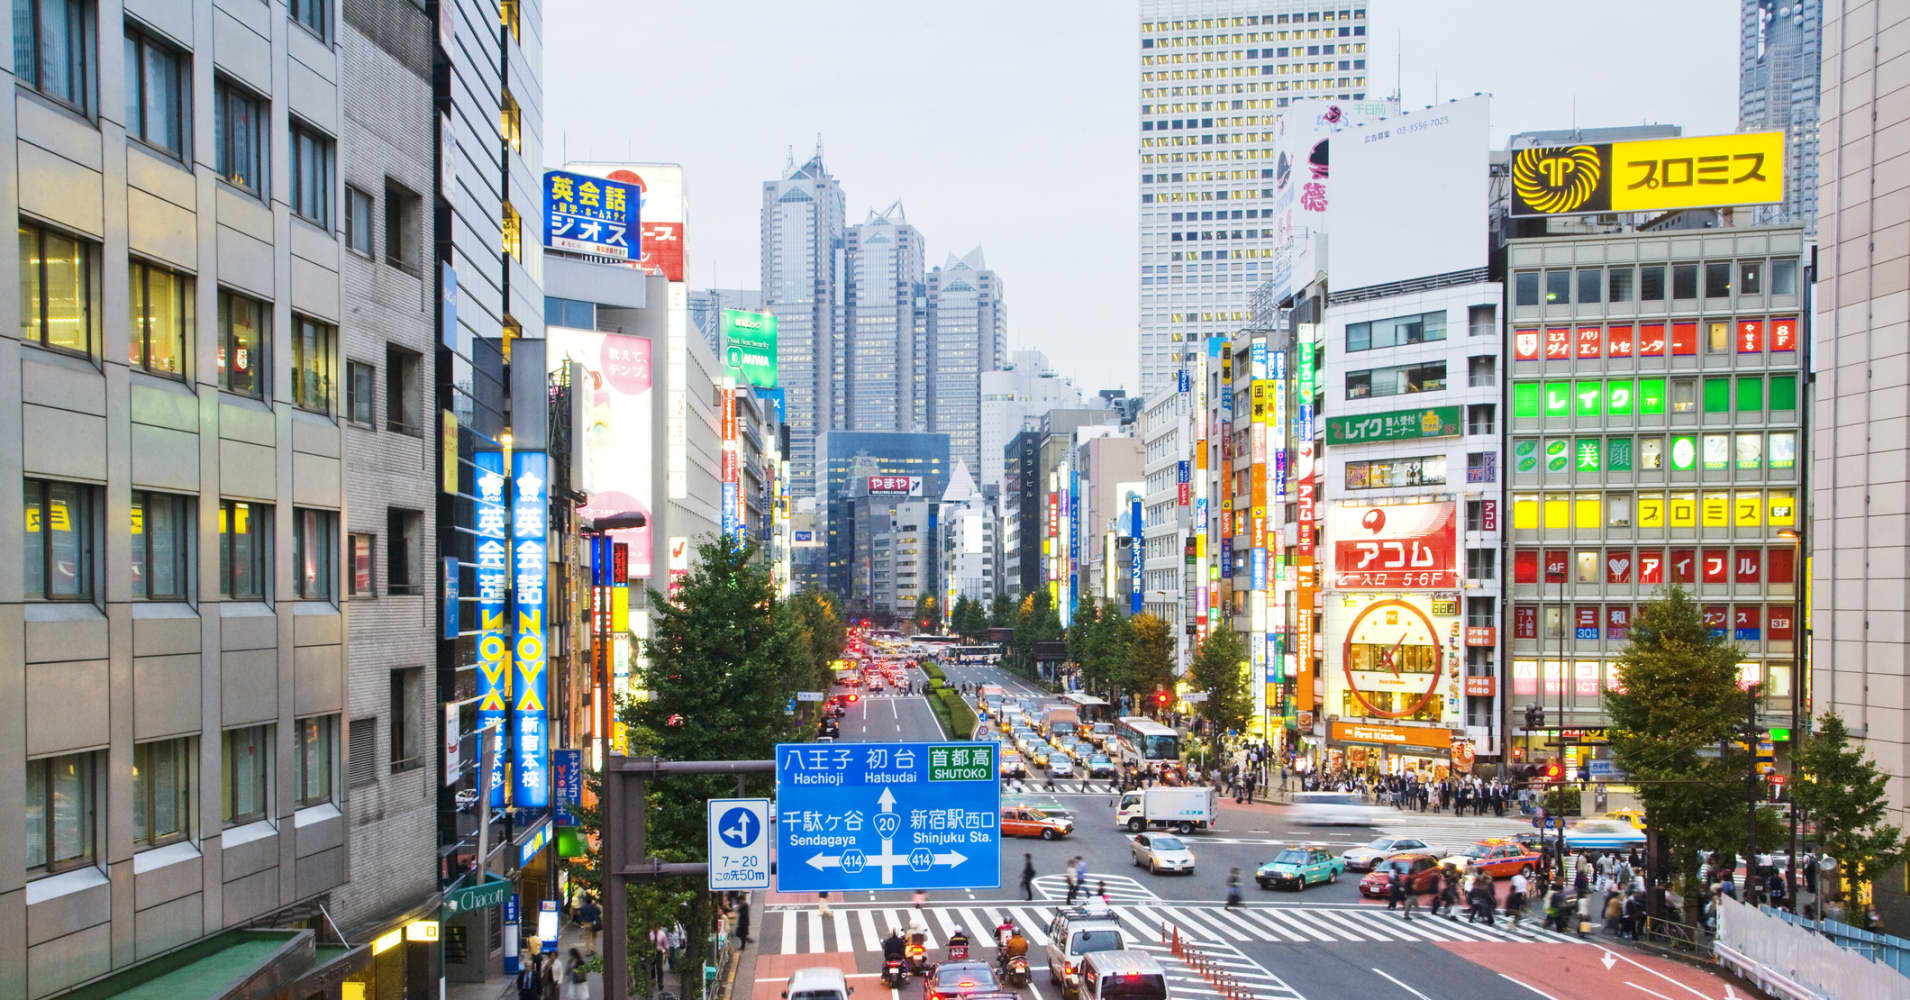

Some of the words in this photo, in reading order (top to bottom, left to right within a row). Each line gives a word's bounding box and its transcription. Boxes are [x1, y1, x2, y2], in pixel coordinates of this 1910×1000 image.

[1397, 116, 1449, 135] 03-3556-7025
[1627, 152, 1766, 190] プロミス
[552, 175, 626, 213] 英会話
[551, 215, 629, 247] ジオス
[1549, 389, 1629, 409] レイク
[1345, 417, 1382, 439] レイク
[1385, 427, 1415, 437] コーナー
[871, 477, 907, 489] やまや
[1299, 485, 1312, 521] アコム
[1643, 504, 1756, 521] プロミス
[1485, 502, 1495, 529] アコム
[516, 507, 544, 604] 英会話
[1356, 541, 1434, 569] アコム
[1548, 562, 1565, 572] 4F
[1642, 558, 1757, 576] アイフル
[1361, 573, 1387, 586] 入口
[1581, 610, 1626, 624] 三和
[1772, 619, 1788, 628] 3F
[516, 609, 545, 711] NOVA
[784, 749, 853, 771] 八王子
[866, 748, 916, 769] 初台
[931, 748, 990, 767] 首都高
[794, 772, 844, 786] Hachioji
[864, 770, 917, 783] Hatsudai
[934, 767, 986, 779] SHUTOKO
[879, 818, 895, 831] 20
[910, 808, 994, 831] 新宿駅西口
[790, 834, 856, 848] Sendagaya
[913, 832, 965, 844] Shinjuku
[969, 831, 992, 843] Sta.
[843, 855, 862, 867] 414
[912, 853, 930, 866] 414
